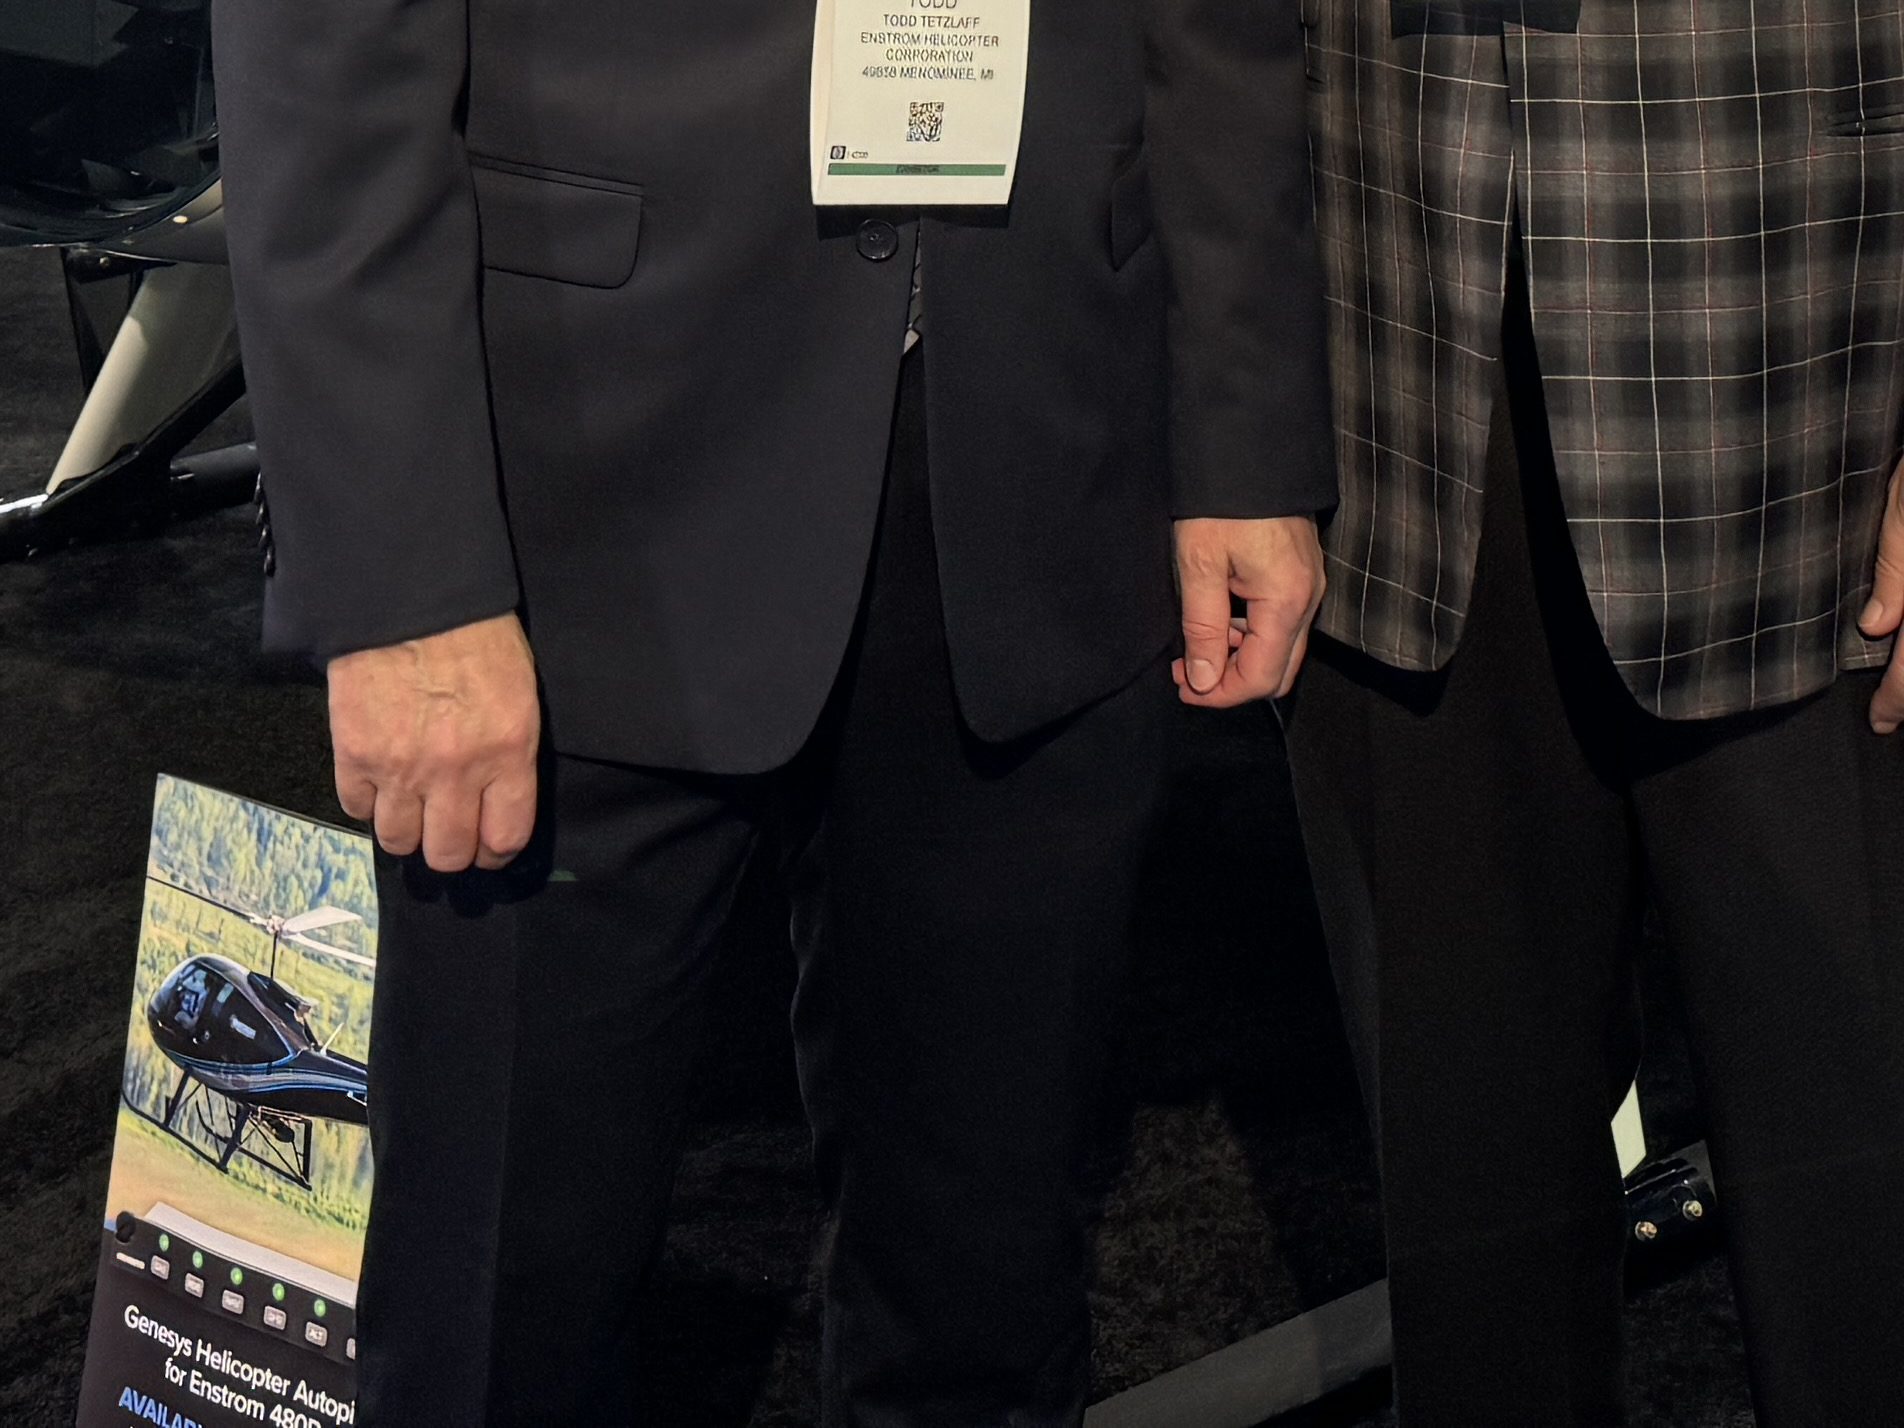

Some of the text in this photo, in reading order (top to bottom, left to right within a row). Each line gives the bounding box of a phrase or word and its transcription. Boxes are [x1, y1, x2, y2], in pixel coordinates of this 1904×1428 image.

[884, 14, 980, 29] TODD TETZLAFF
[886, 48, 974, 63] CORPORATION
[124, 1305, 192, 1357] Genesys
[196, 1338, 291, 1396] Helicopter
[164, 1357, 187, 1387] for
[189, 1372, 265, 1421] Enstrom
